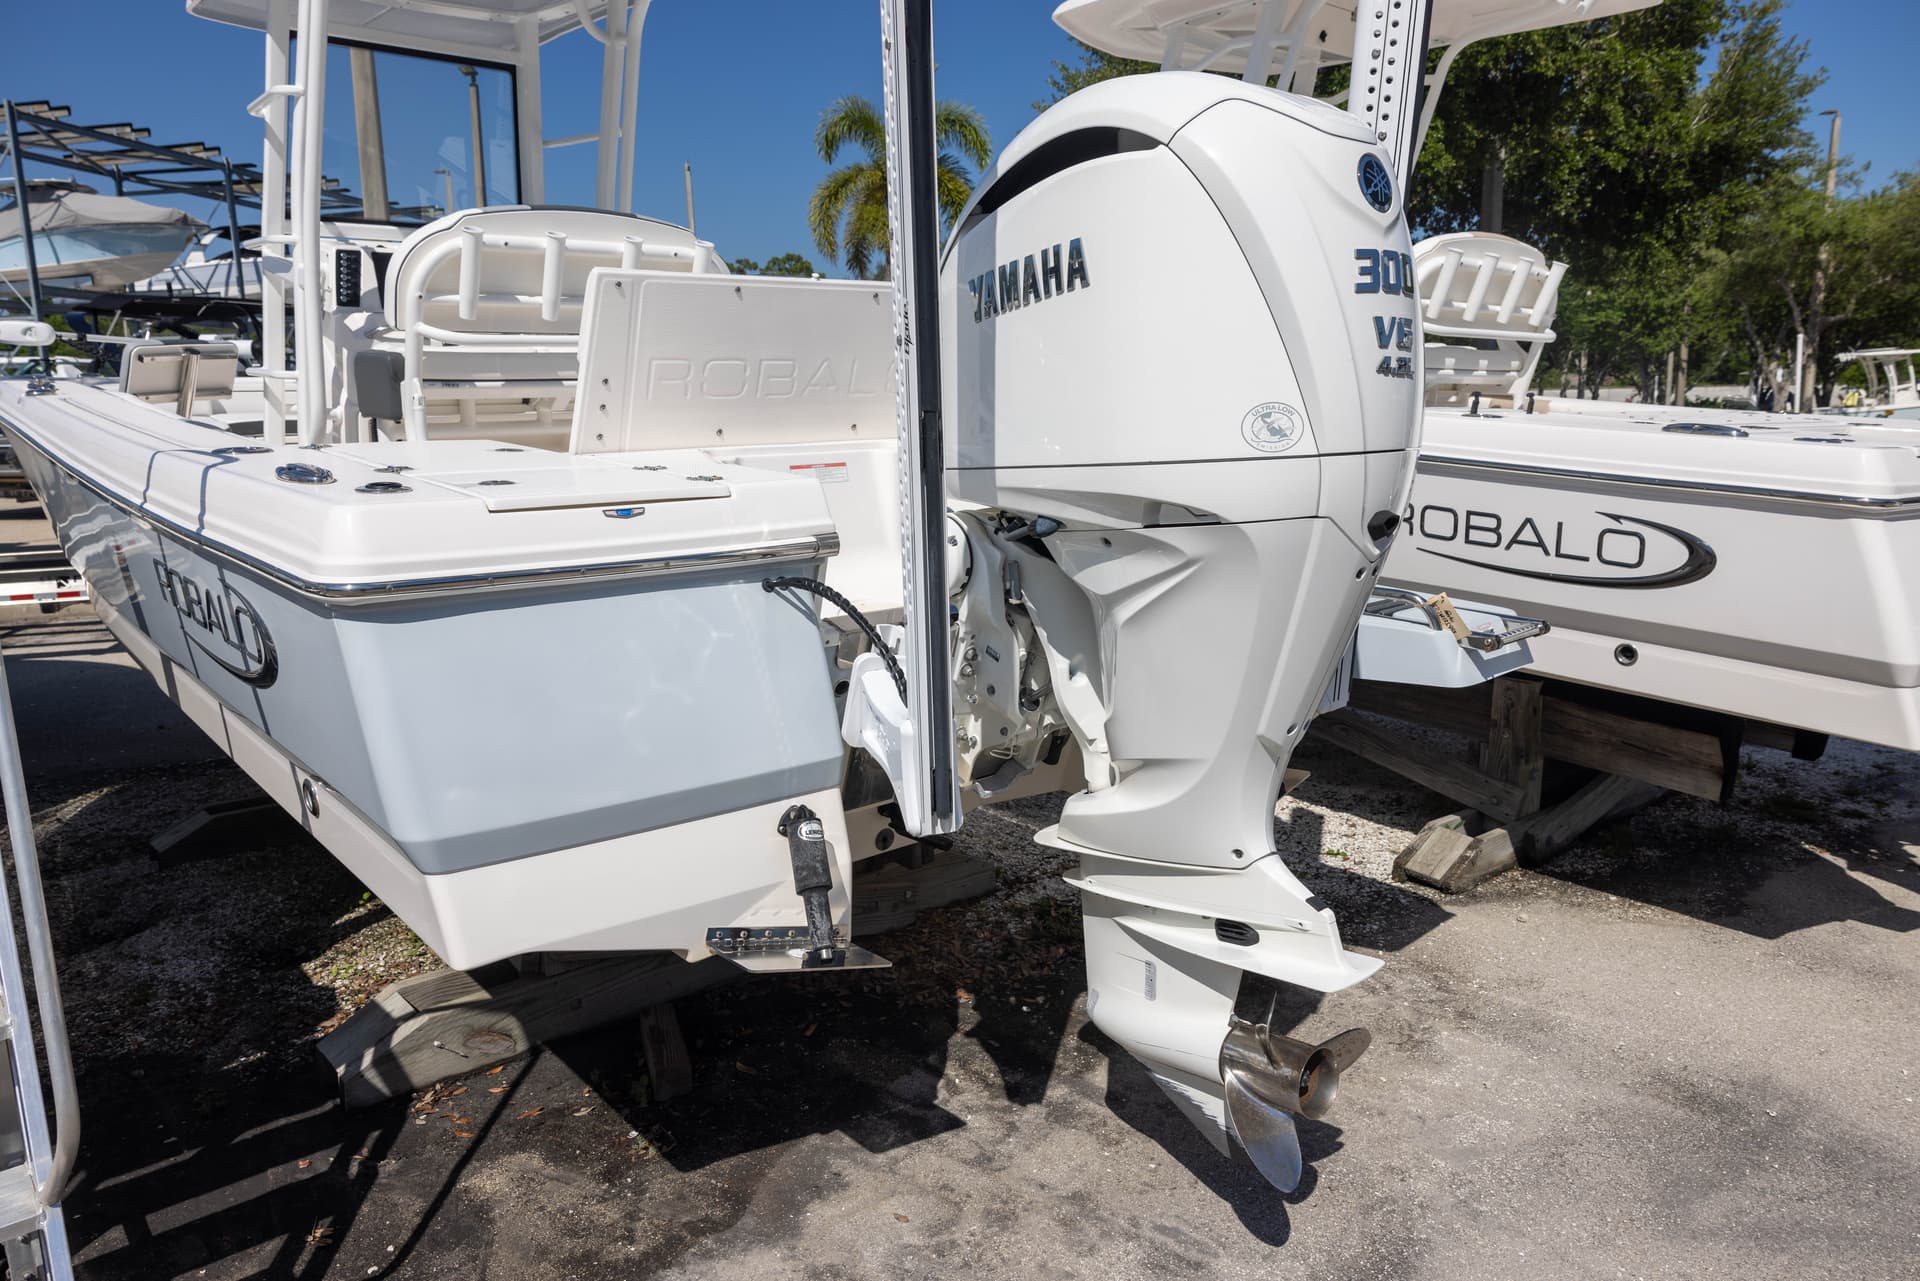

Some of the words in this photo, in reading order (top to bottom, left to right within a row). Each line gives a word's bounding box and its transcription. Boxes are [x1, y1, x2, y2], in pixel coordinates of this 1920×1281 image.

[968, 237, 1090, 323] YAMAHA
[1355, 248, 1414, 299] 300
[646, 357, 897, 400] ROBAL
[1251, 404, 1277, 417] ULTRA
[1277, 404, 1296, 417] LOW
[153, 558, 264, 665] ROBALO
